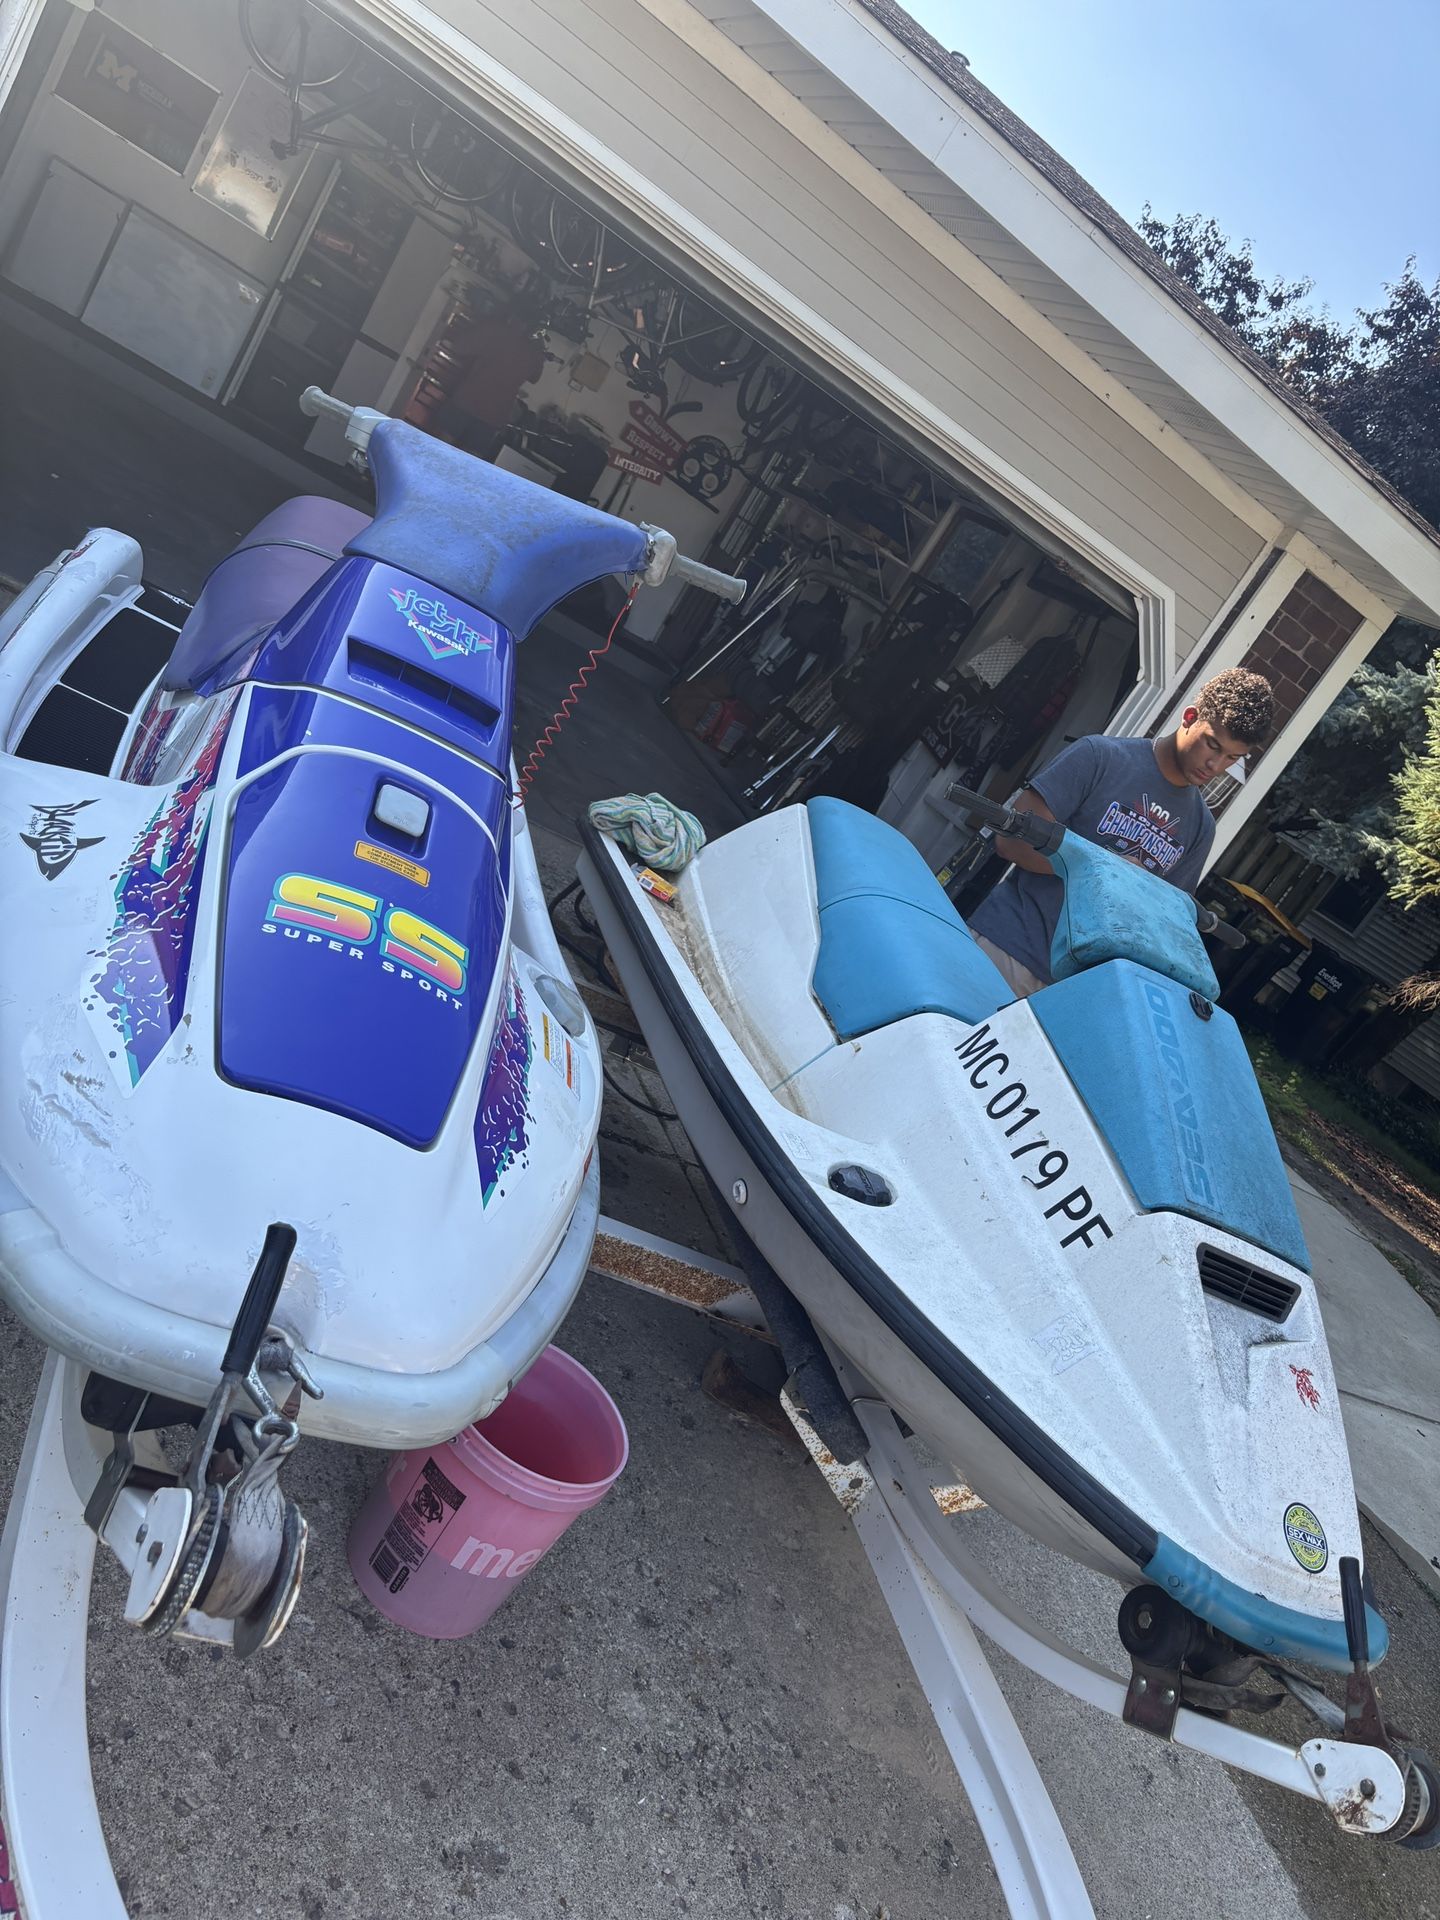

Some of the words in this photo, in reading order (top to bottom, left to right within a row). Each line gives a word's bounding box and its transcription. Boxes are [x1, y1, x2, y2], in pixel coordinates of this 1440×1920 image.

[626, 429, 666, 461] RESPECT
[644, 413, 683, 454] GROWTH
[613, 454, 661, 481] INTEGRITY
[407, 619, 469, 656] Kawasaki
[1097, 801, 1185, 873] CHAMPONSHIPS
[1129, 810, 1175, 842] HOCKEY
[265, 872, 470, 996] SS
[261, 923, 365, 960] SUPER
[381, 961, 463, 1010] SPORT
[954, 1023, 1010, 1090] MC
[1043, 1185, 1114, 1249] PF
[1288, 1527, 1305, 1541] SEX
[1304, 1533, 1323, 1549] WAX
